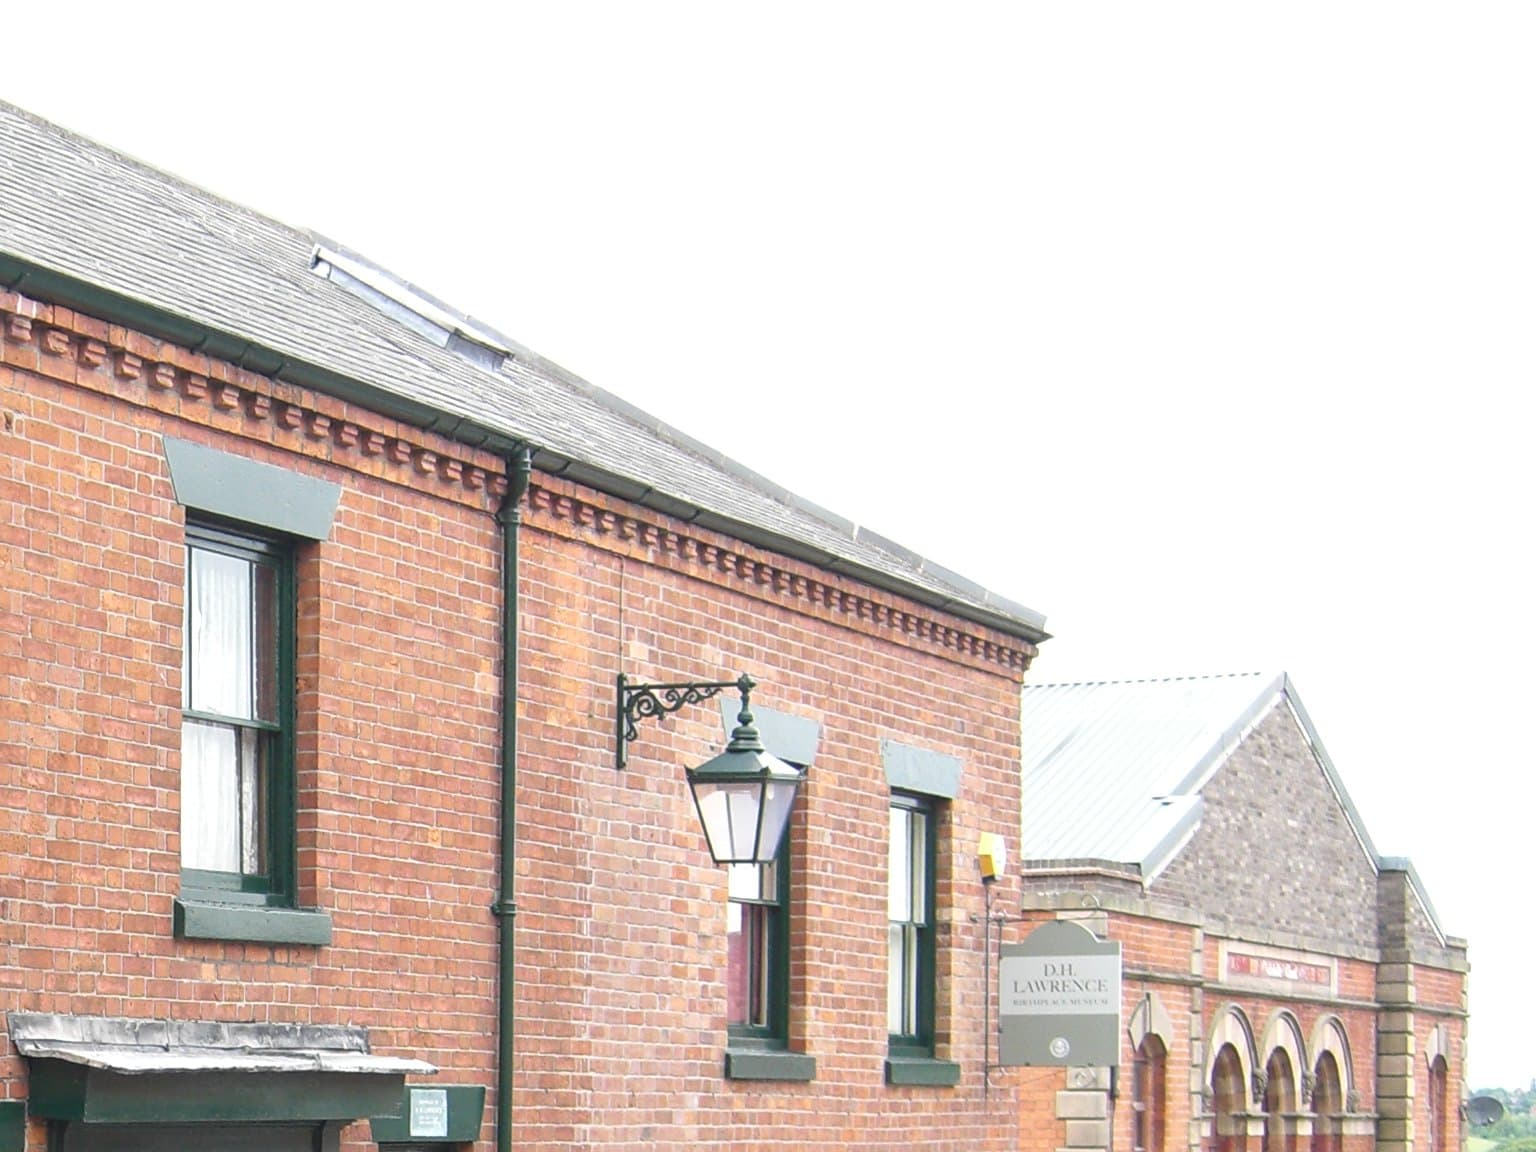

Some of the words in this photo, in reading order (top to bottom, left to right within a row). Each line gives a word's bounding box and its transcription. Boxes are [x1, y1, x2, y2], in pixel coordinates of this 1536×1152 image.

[1043, 963, 1077, 977] D.H.
[1013, 980, 1109, 993] LAWRENCE
[1070, 997, 1109, 1006] MUSEUM
